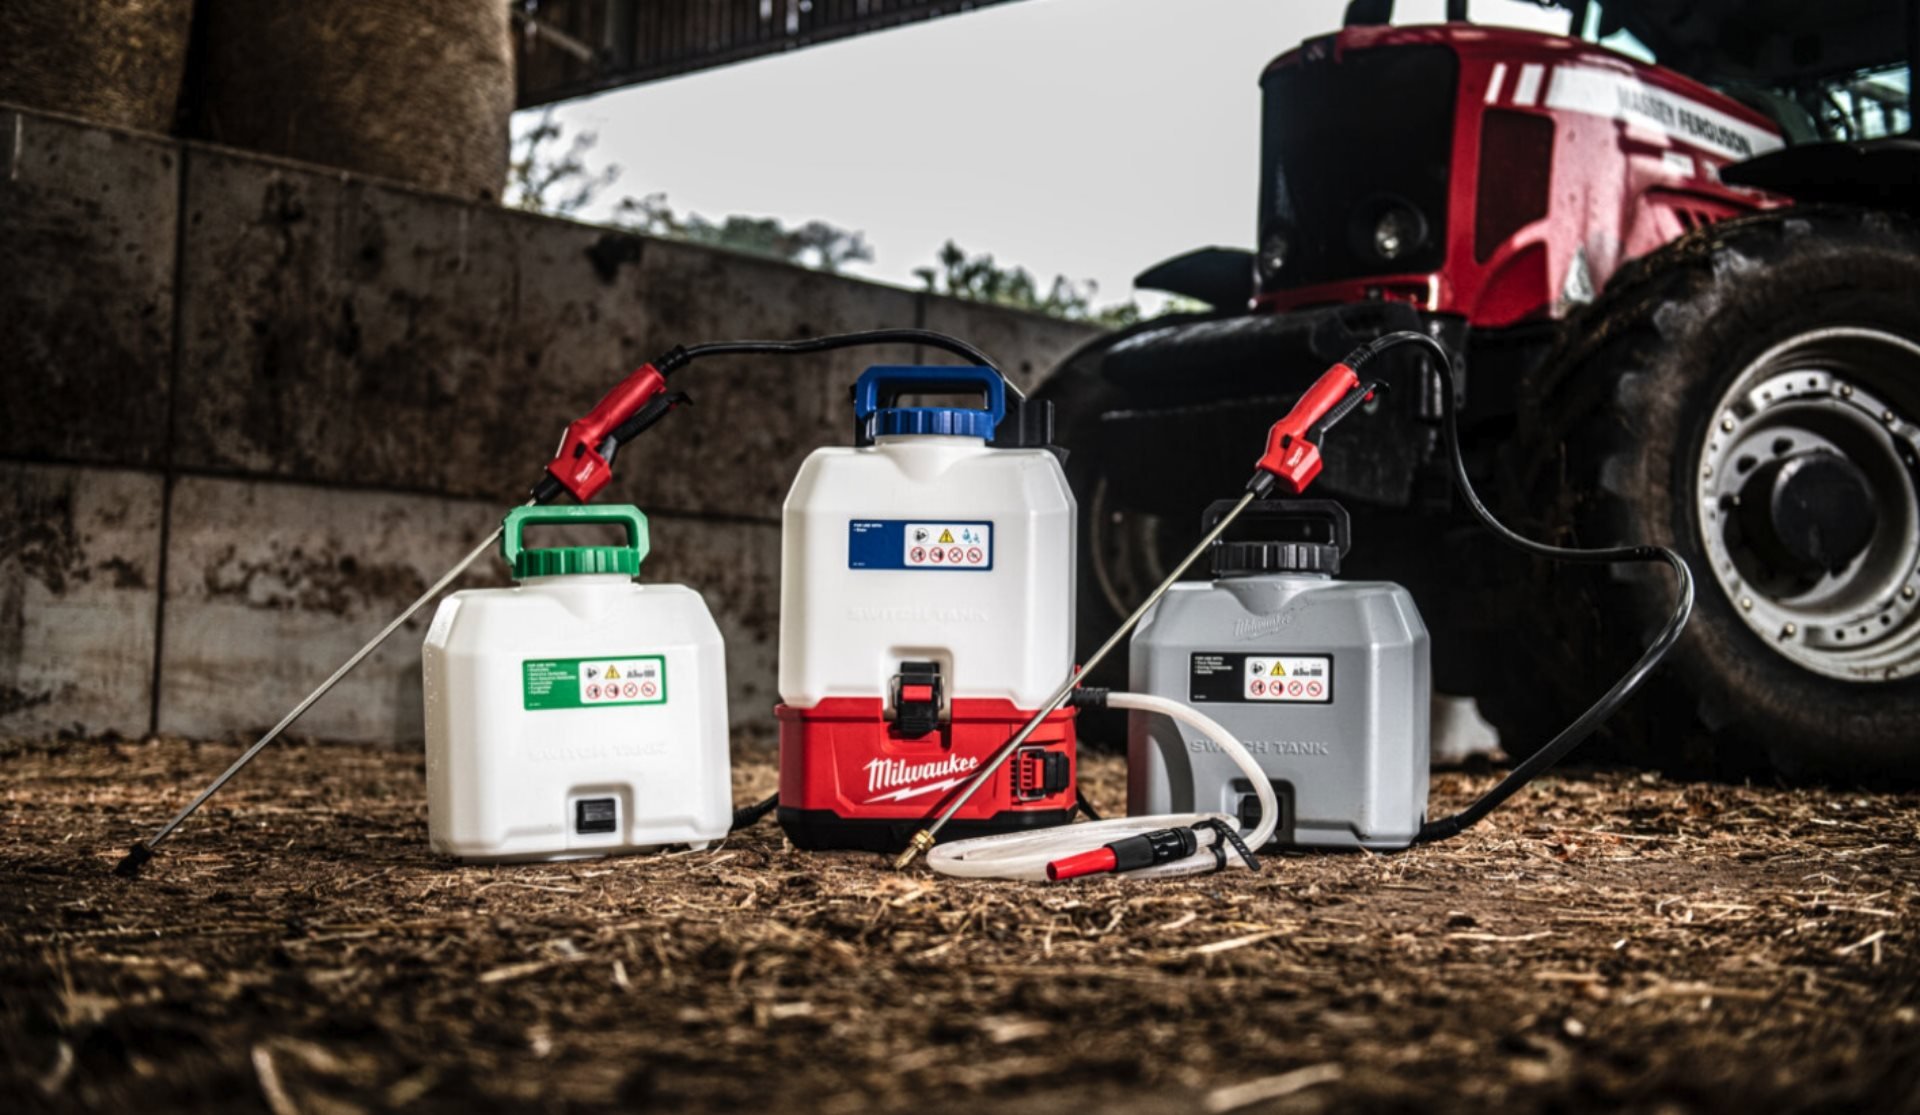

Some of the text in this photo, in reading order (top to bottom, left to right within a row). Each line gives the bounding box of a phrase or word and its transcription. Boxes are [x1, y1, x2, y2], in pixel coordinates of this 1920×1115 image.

[1616, 84, 1752, 155] MASSEY FERGUSON
[1191, 739, 1329, 756] SWCH TANK
[862, 753, 979, 793] Milwaukee
